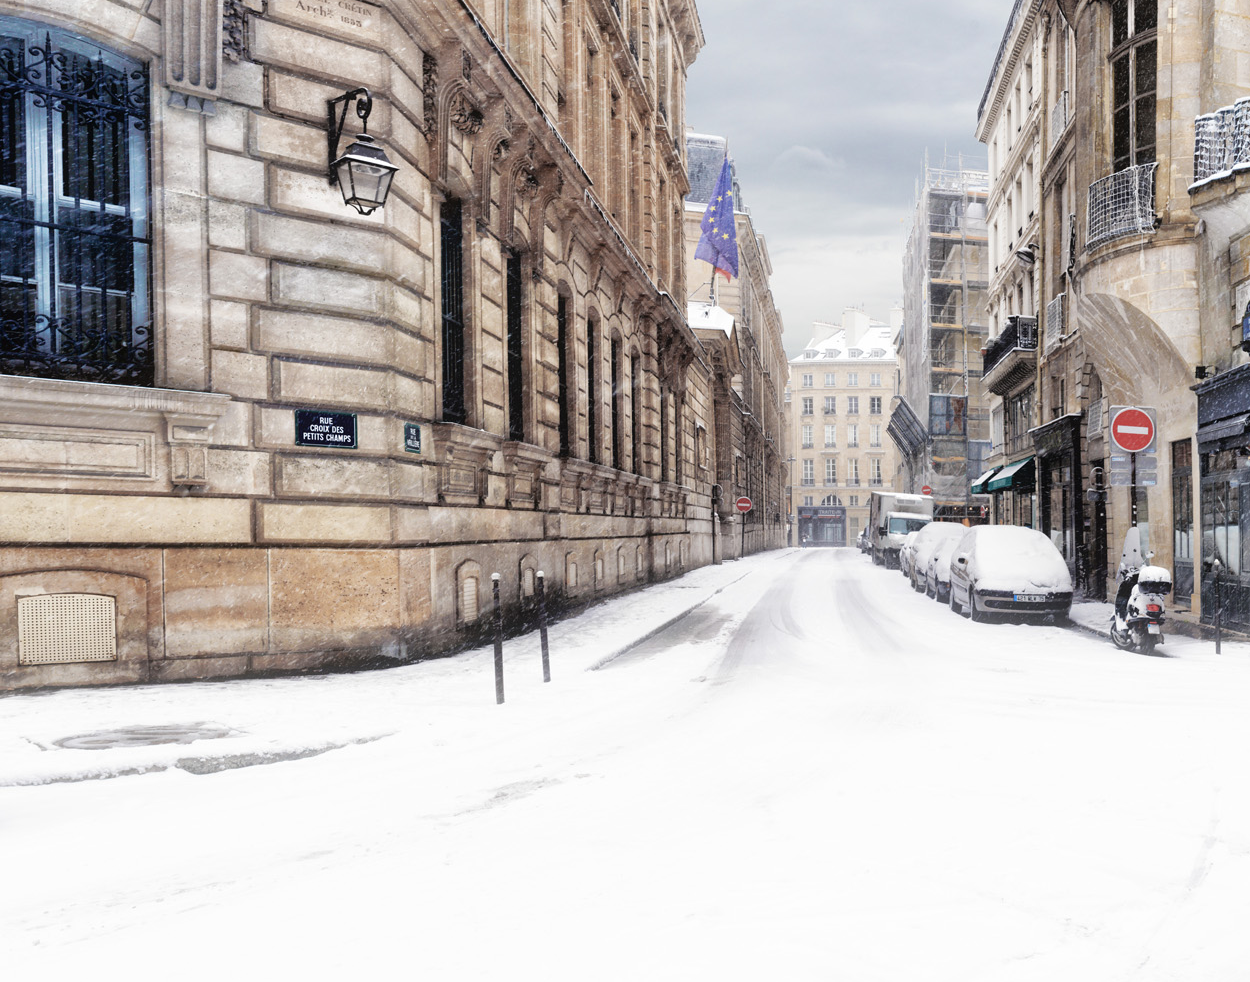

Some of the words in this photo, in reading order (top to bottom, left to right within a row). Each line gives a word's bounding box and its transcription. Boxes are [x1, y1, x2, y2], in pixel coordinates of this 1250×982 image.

[338, 1, 372, 17] CRÉTIN
[319, 417, 334, 426] RUE
[309, 424, 330, 434] CROIX
[331, 425, 345, 435] DES
[303, 432, 325, 441] PETITS
[325, 434, 352, 444] CHAMPS
